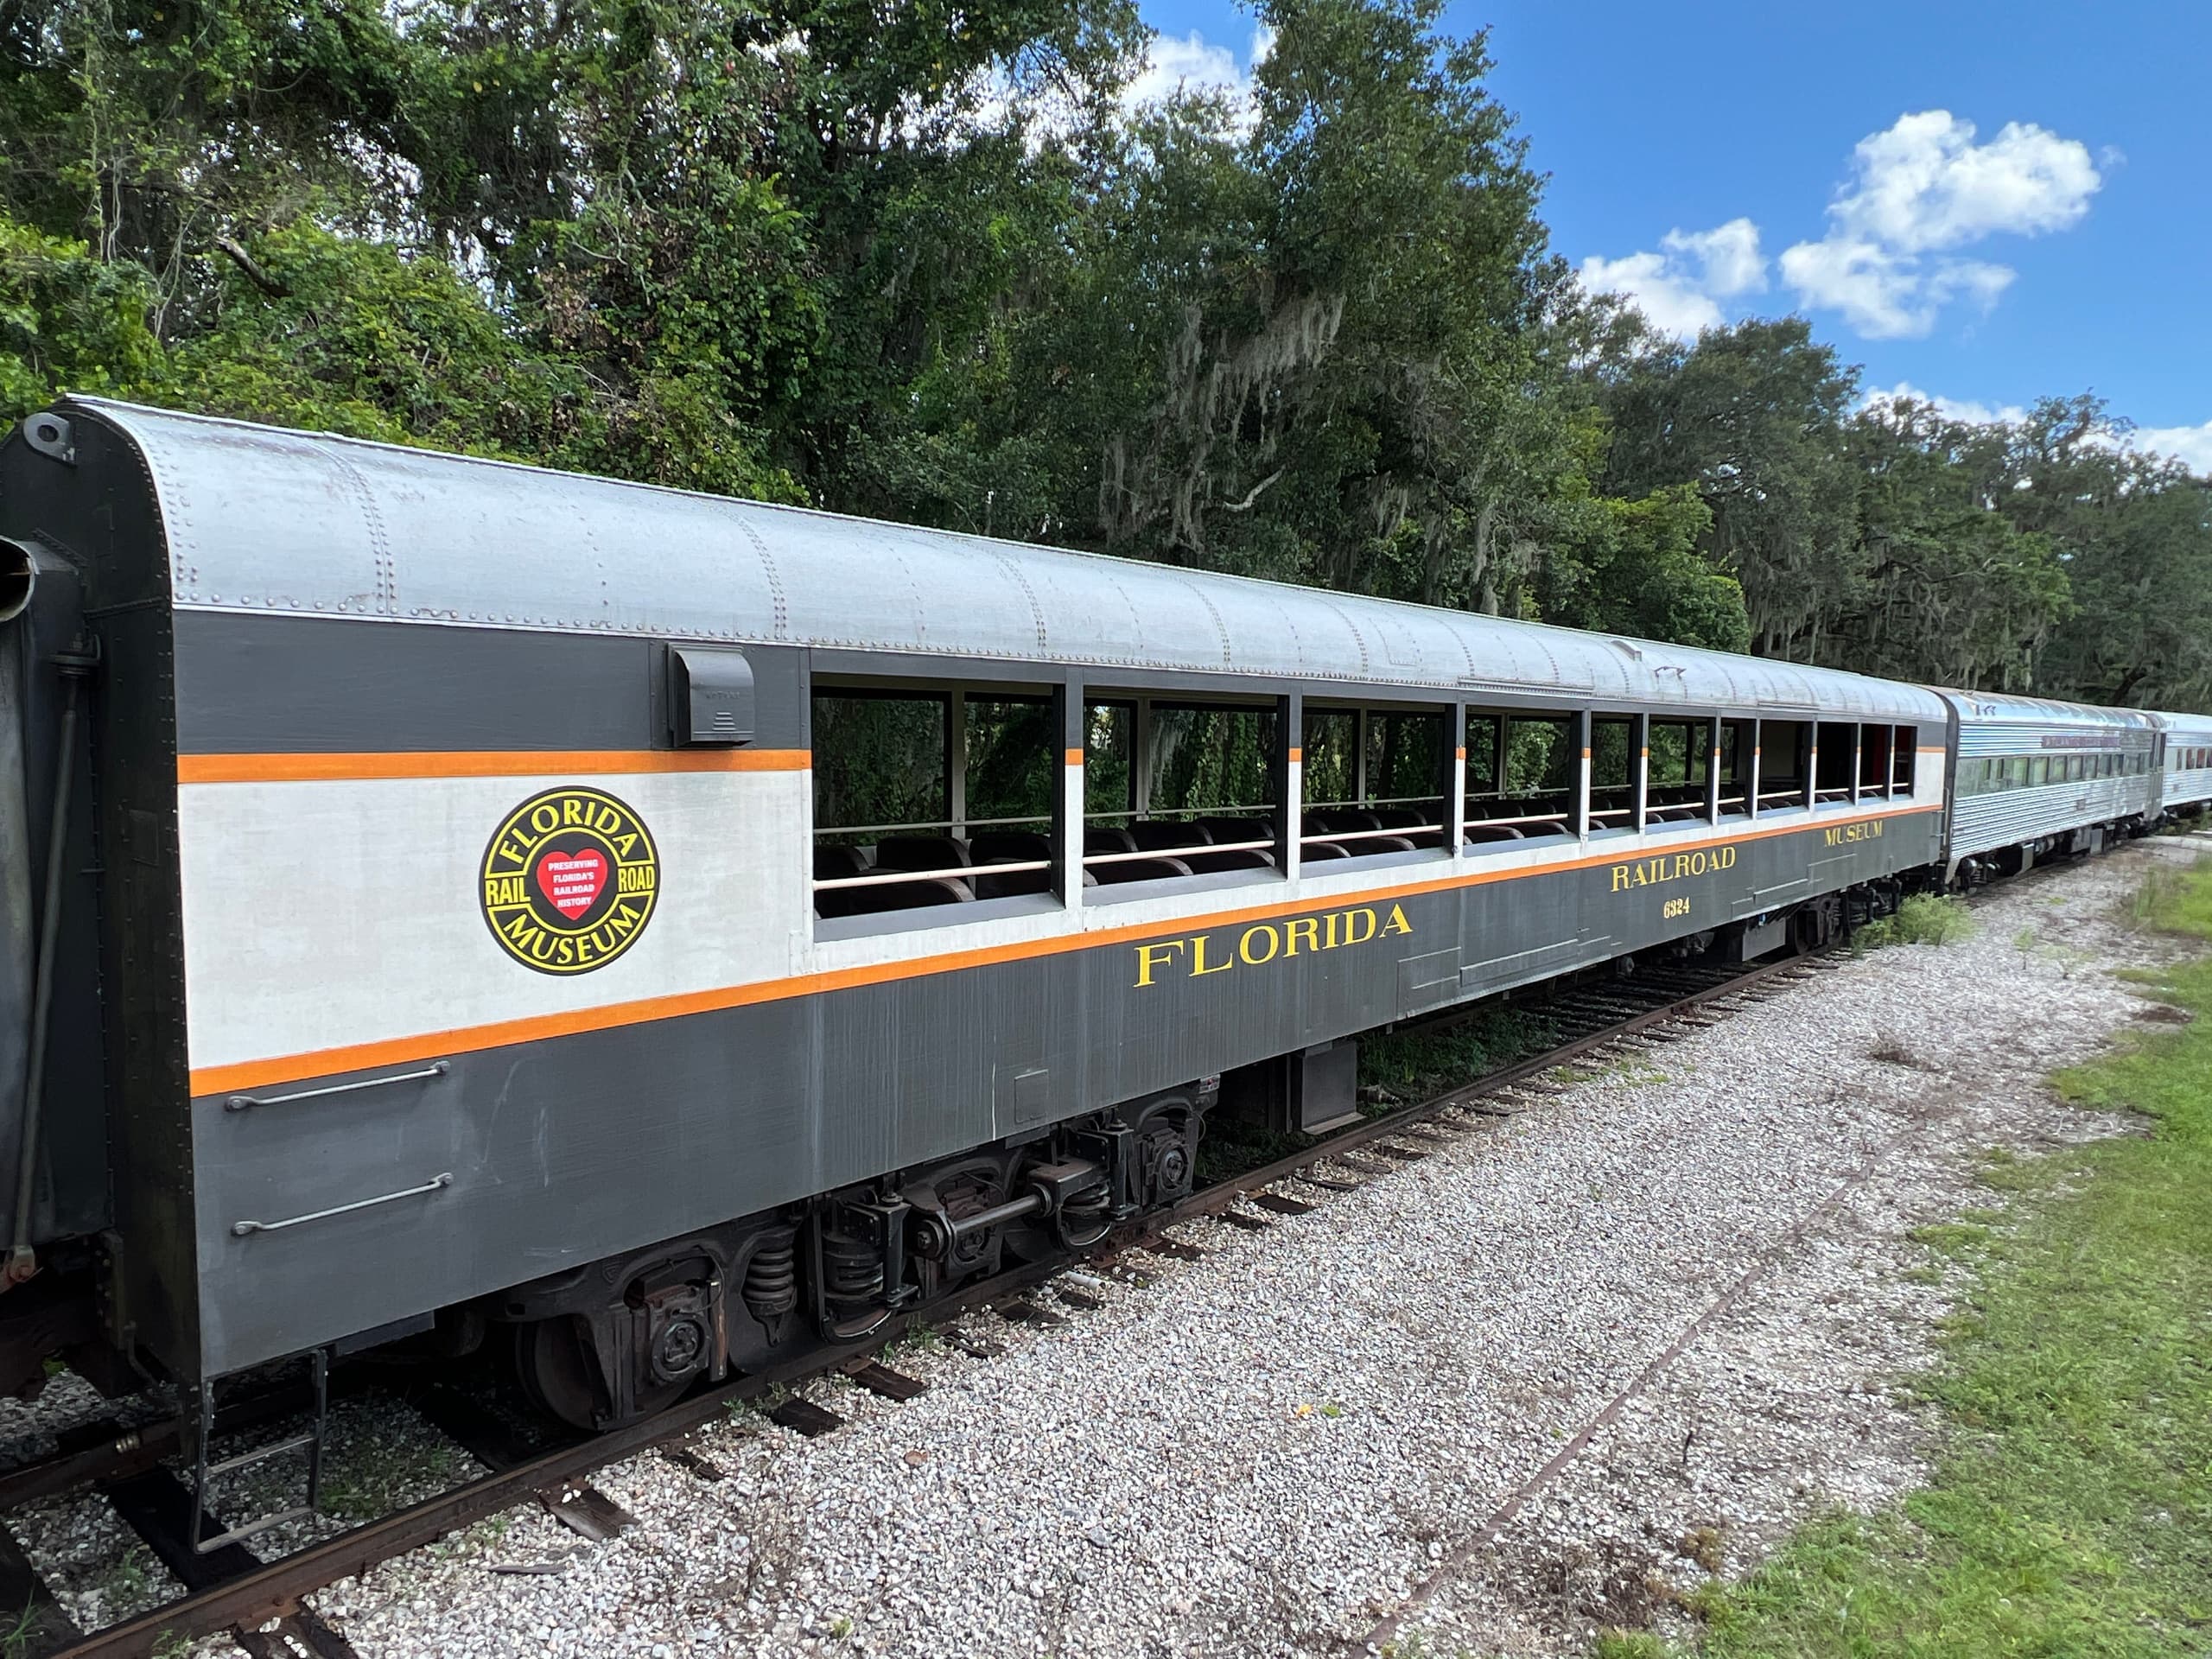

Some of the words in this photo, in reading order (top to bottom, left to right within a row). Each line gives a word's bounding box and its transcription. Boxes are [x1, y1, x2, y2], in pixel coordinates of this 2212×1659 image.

[499, 799, 638, 864] FLORIDA
[1824, 821, 1883, 847] MUSEUM
[548, 859, 599, 872] PRESERVING
[553, 872, 594, 884] FLORIDA'S
[1611, 847, 1736, 892] RAILROAD
[486, 877, 531, 906] RAIL
[618, 867, 655, 893] ROAD
[553, 884, 594, 896] RAILROAD
[557, 896, 592, 908] HISTORY
[1663, 896, 1690, 919] 6324
[503, 904, 641, 963] MUSEUM
[1133, 903, 1413, 988] FLORIDA
